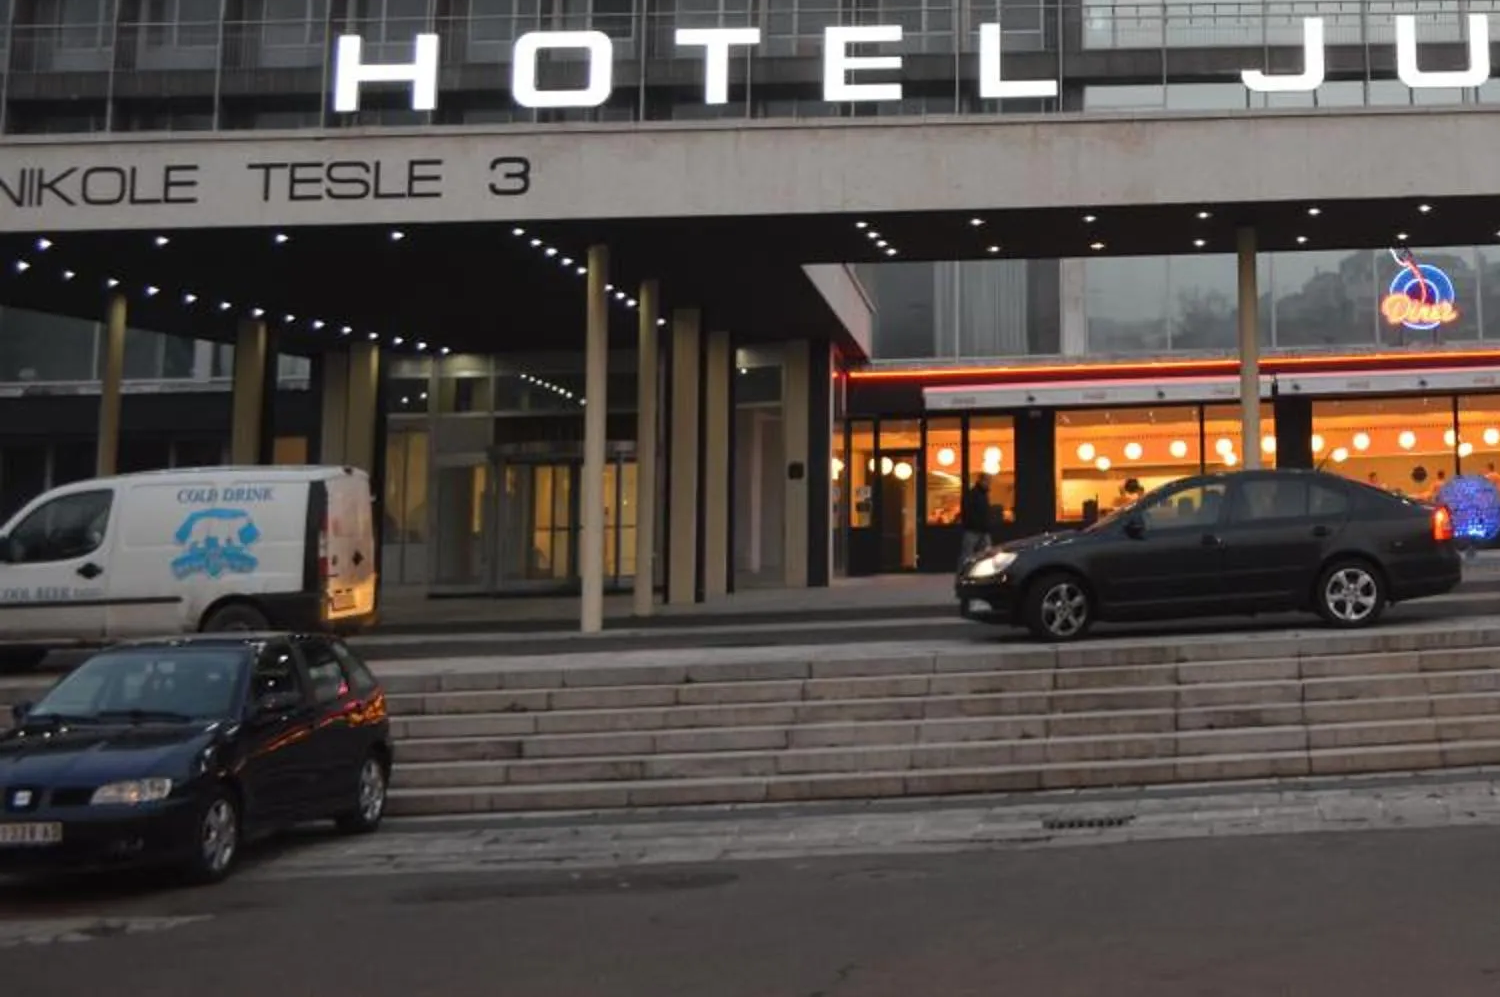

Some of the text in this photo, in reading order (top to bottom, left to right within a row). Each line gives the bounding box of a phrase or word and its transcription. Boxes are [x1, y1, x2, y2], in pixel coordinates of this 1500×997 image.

[334, 23, 1058, 111] HOTEL
[0, 156, 532, 208] NIKOLE TESLE 3
[1381, 293, 1459, 324] Diner
[176, 486, 275, 503] COLD DRINK
